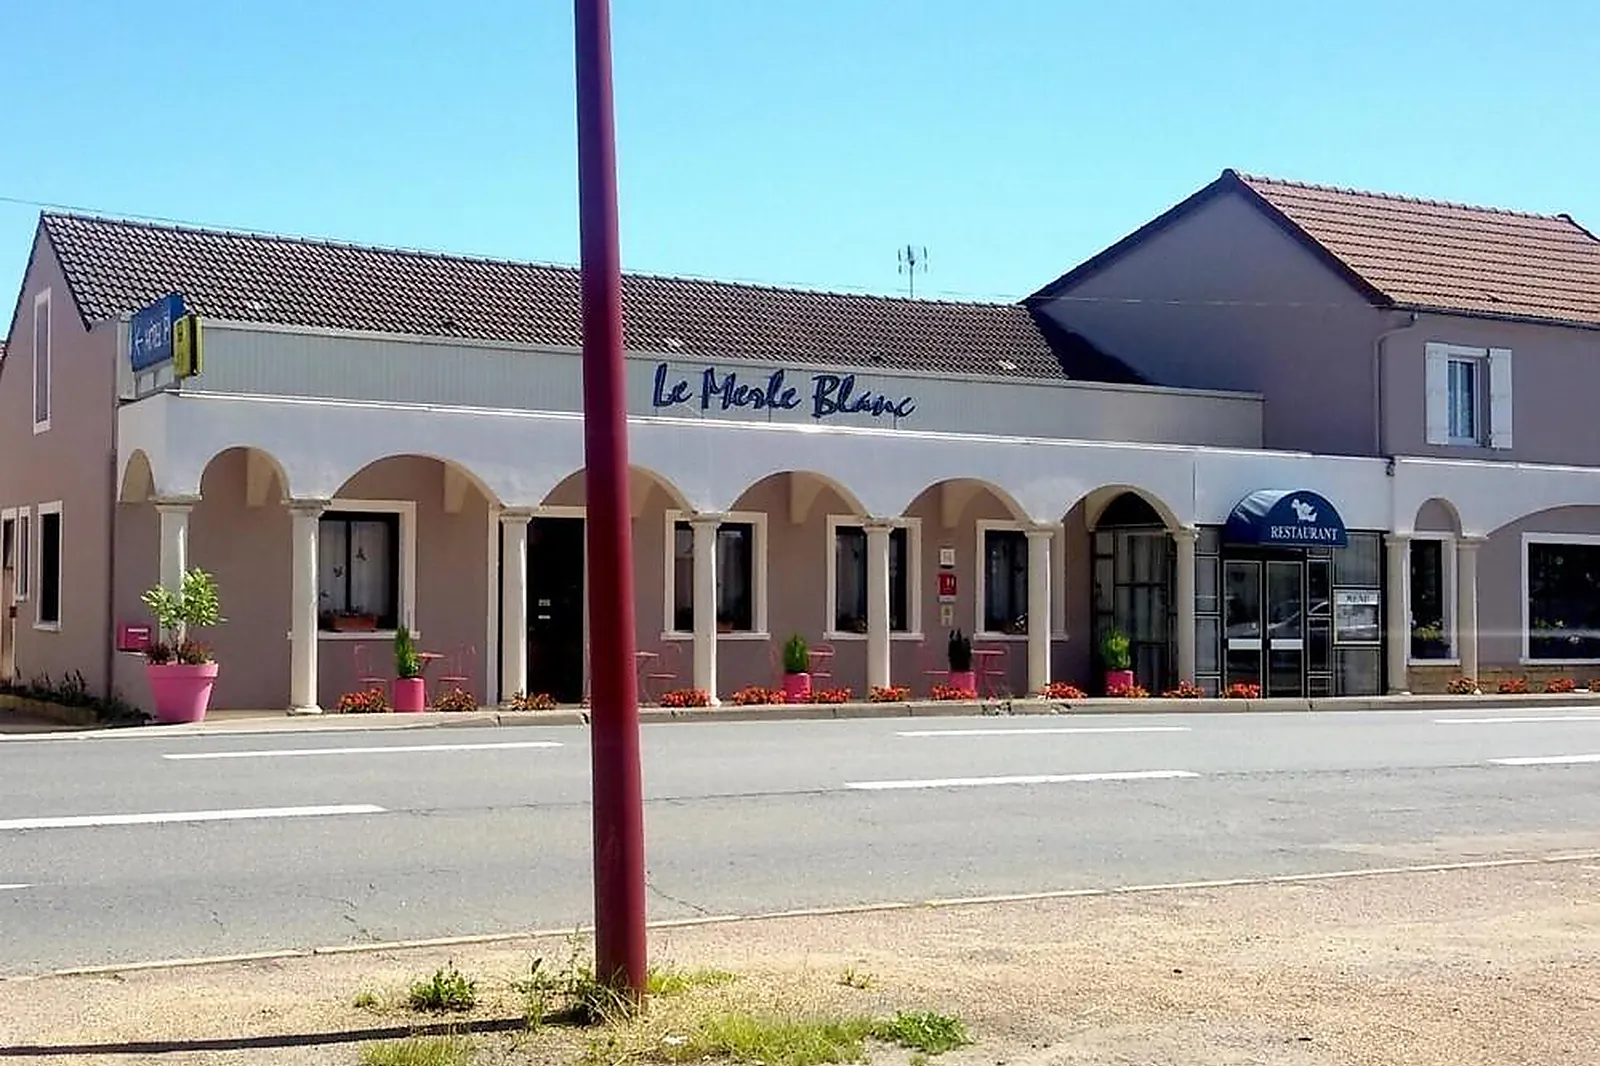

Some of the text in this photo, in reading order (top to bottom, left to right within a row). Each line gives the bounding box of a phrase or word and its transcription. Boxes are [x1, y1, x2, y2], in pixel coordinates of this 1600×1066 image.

[653, 363, 916, 418] Le Merle Blanc
[1271, 525, 1338, 541] RESTAURANT
